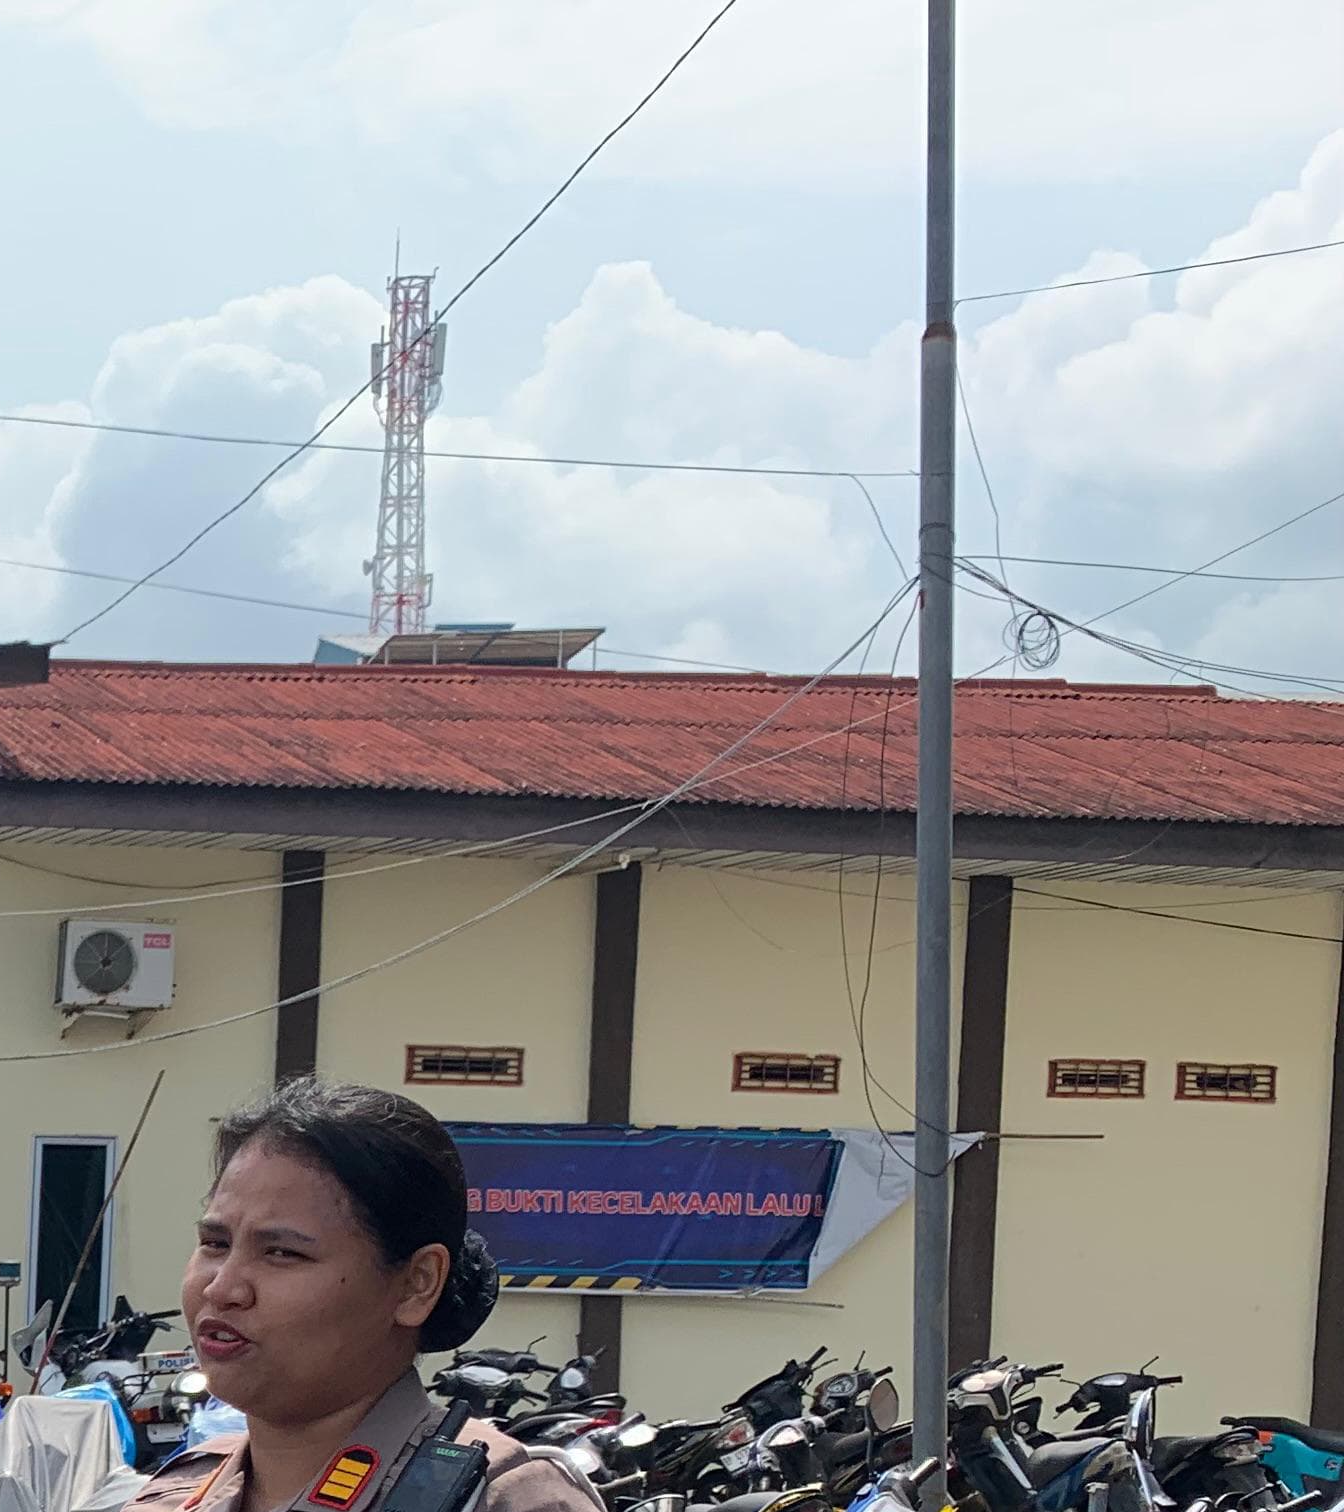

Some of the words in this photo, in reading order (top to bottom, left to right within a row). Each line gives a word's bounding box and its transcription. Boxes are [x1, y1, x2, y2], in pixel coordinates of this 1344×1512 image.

[486, 1188, 563, 1214] BUKTI
[567, 1190, 741, 1216] KECELAKAAN
[746, 1193, 811, 1218] LALU
